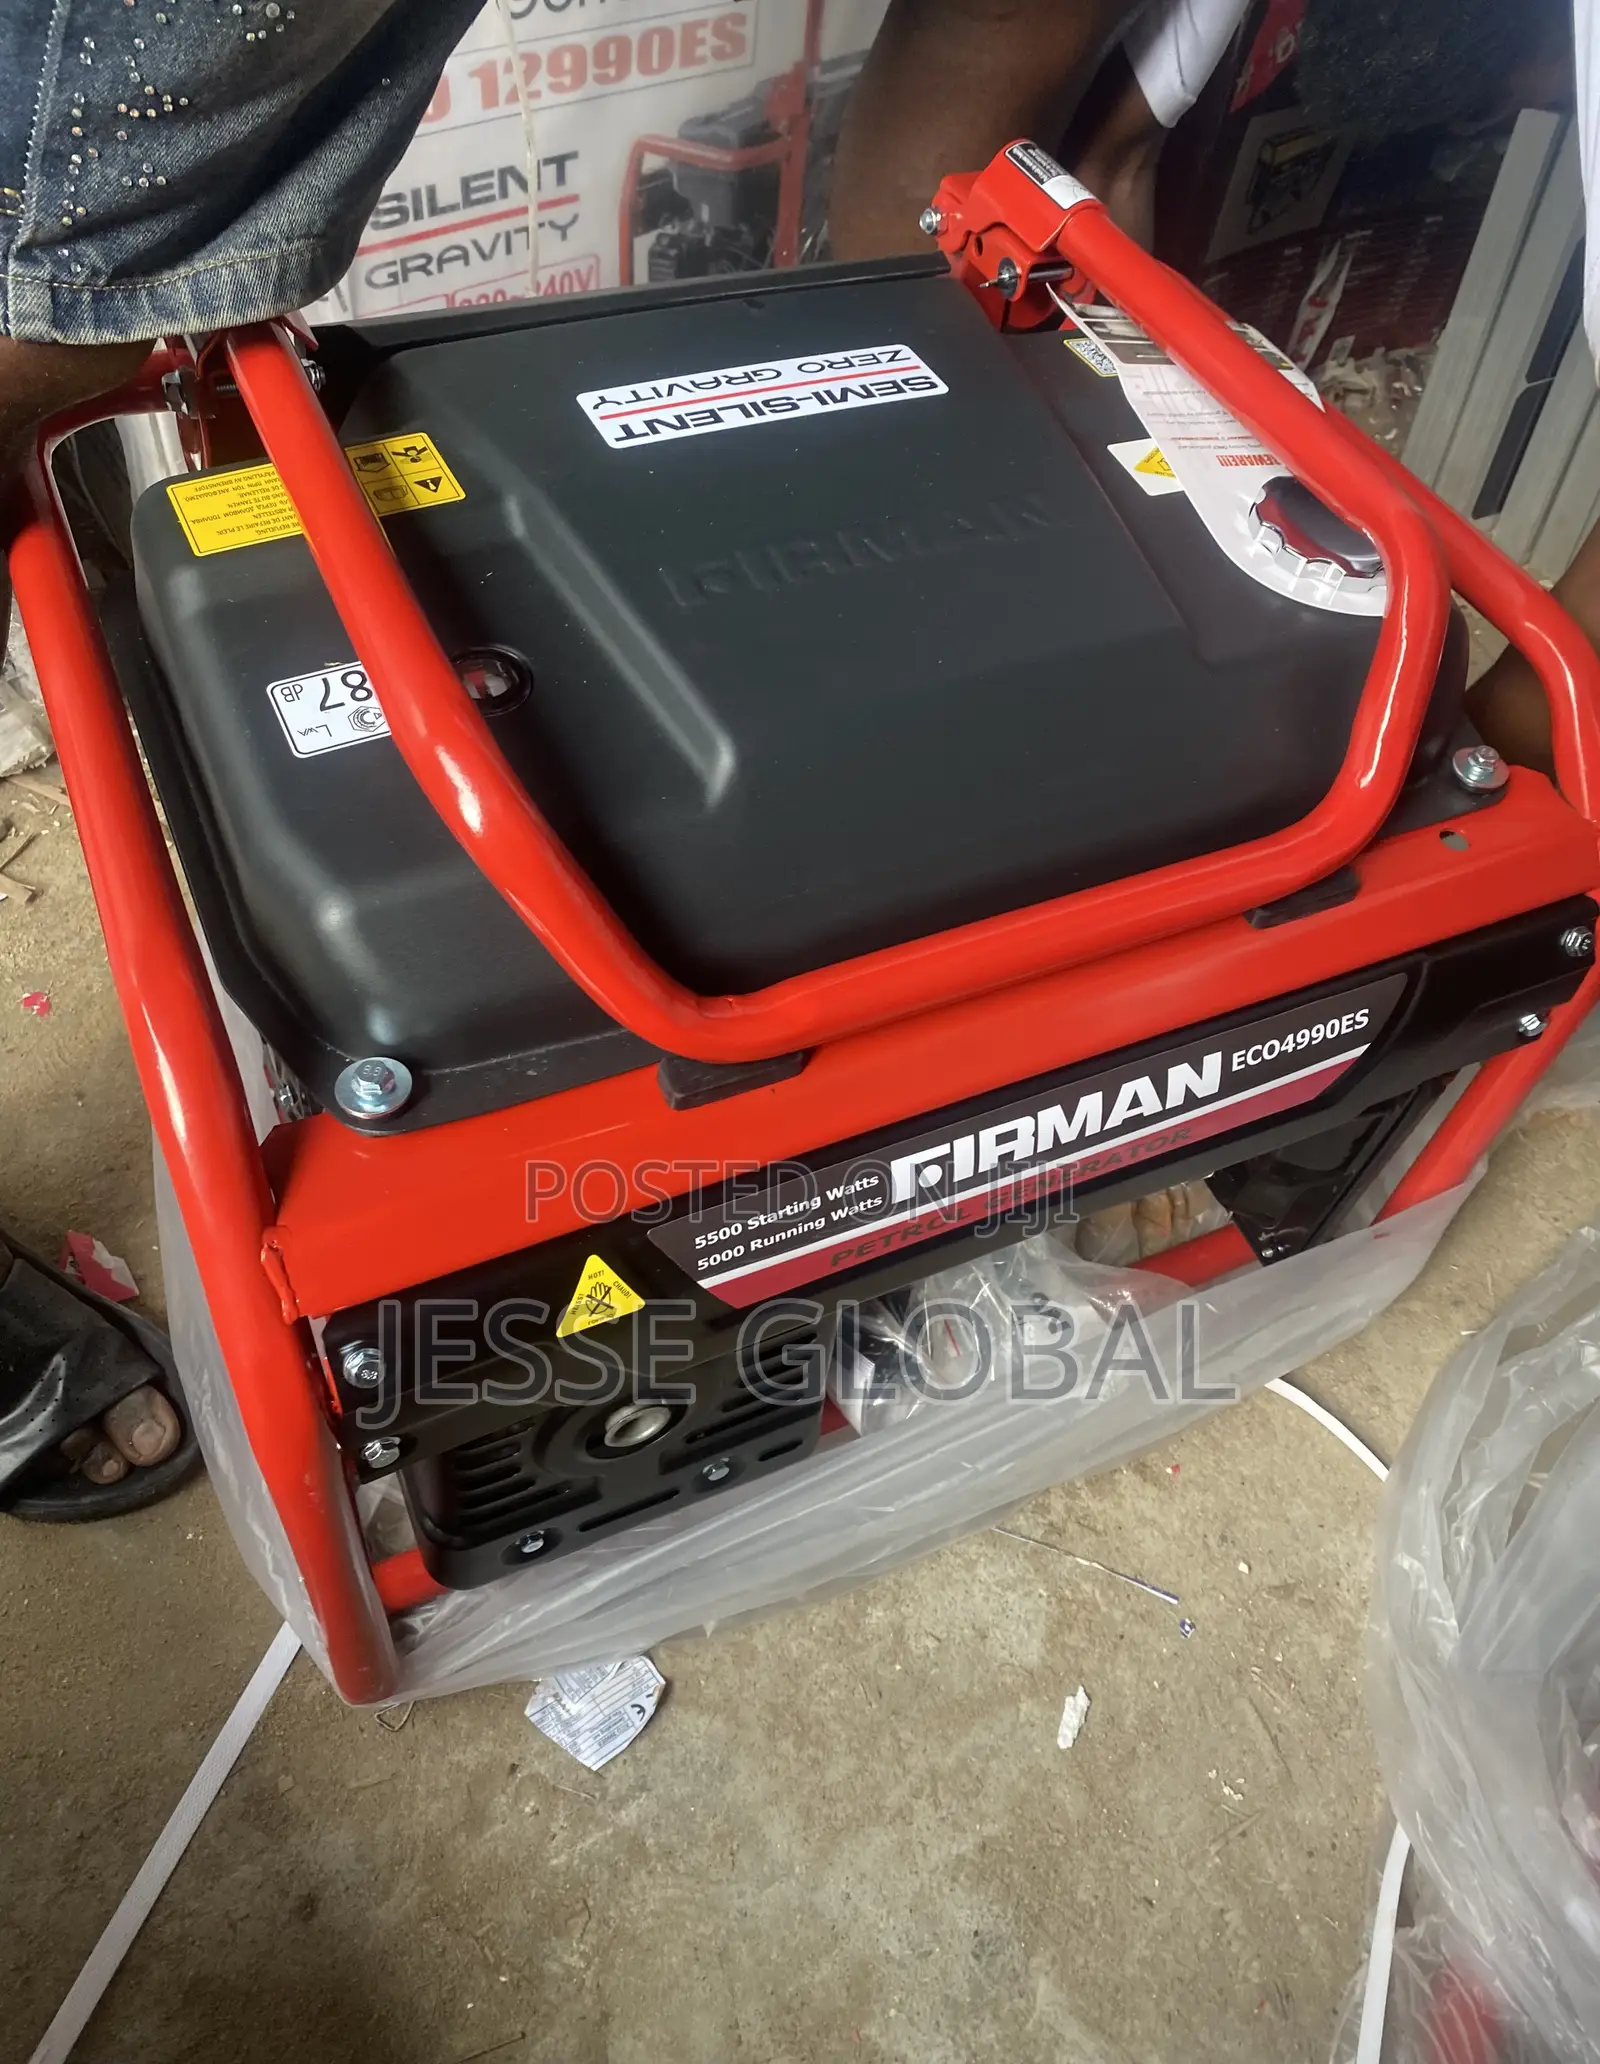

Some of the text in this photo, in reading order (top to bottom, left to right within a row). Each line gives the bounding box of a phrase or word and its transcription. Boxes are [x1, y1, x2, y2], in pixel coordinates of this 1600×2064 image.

[469, 12, 746, 111] 12990ES
[365, 213, 579, 289] GRAVITY
[593, 349, 911, 411] ZERO GRAVITY
[613, 375, 939, 442] SEMI-SILENT
[280, 670, 373, 712] 87 dB
[890, 1009, 1370, 1204] FIRMAN ECO4990ES
[695, 1175, 880, 1249] 5500 Starting Watts
[698, 1196, 883, 1270] 5000 Running Watts
[829, 1127, 1192, 1268] PETROL GENERATOR
[588, 1270, 605, 1280] HOT!
[613, 1281, 632, 1299] CHAUD!
